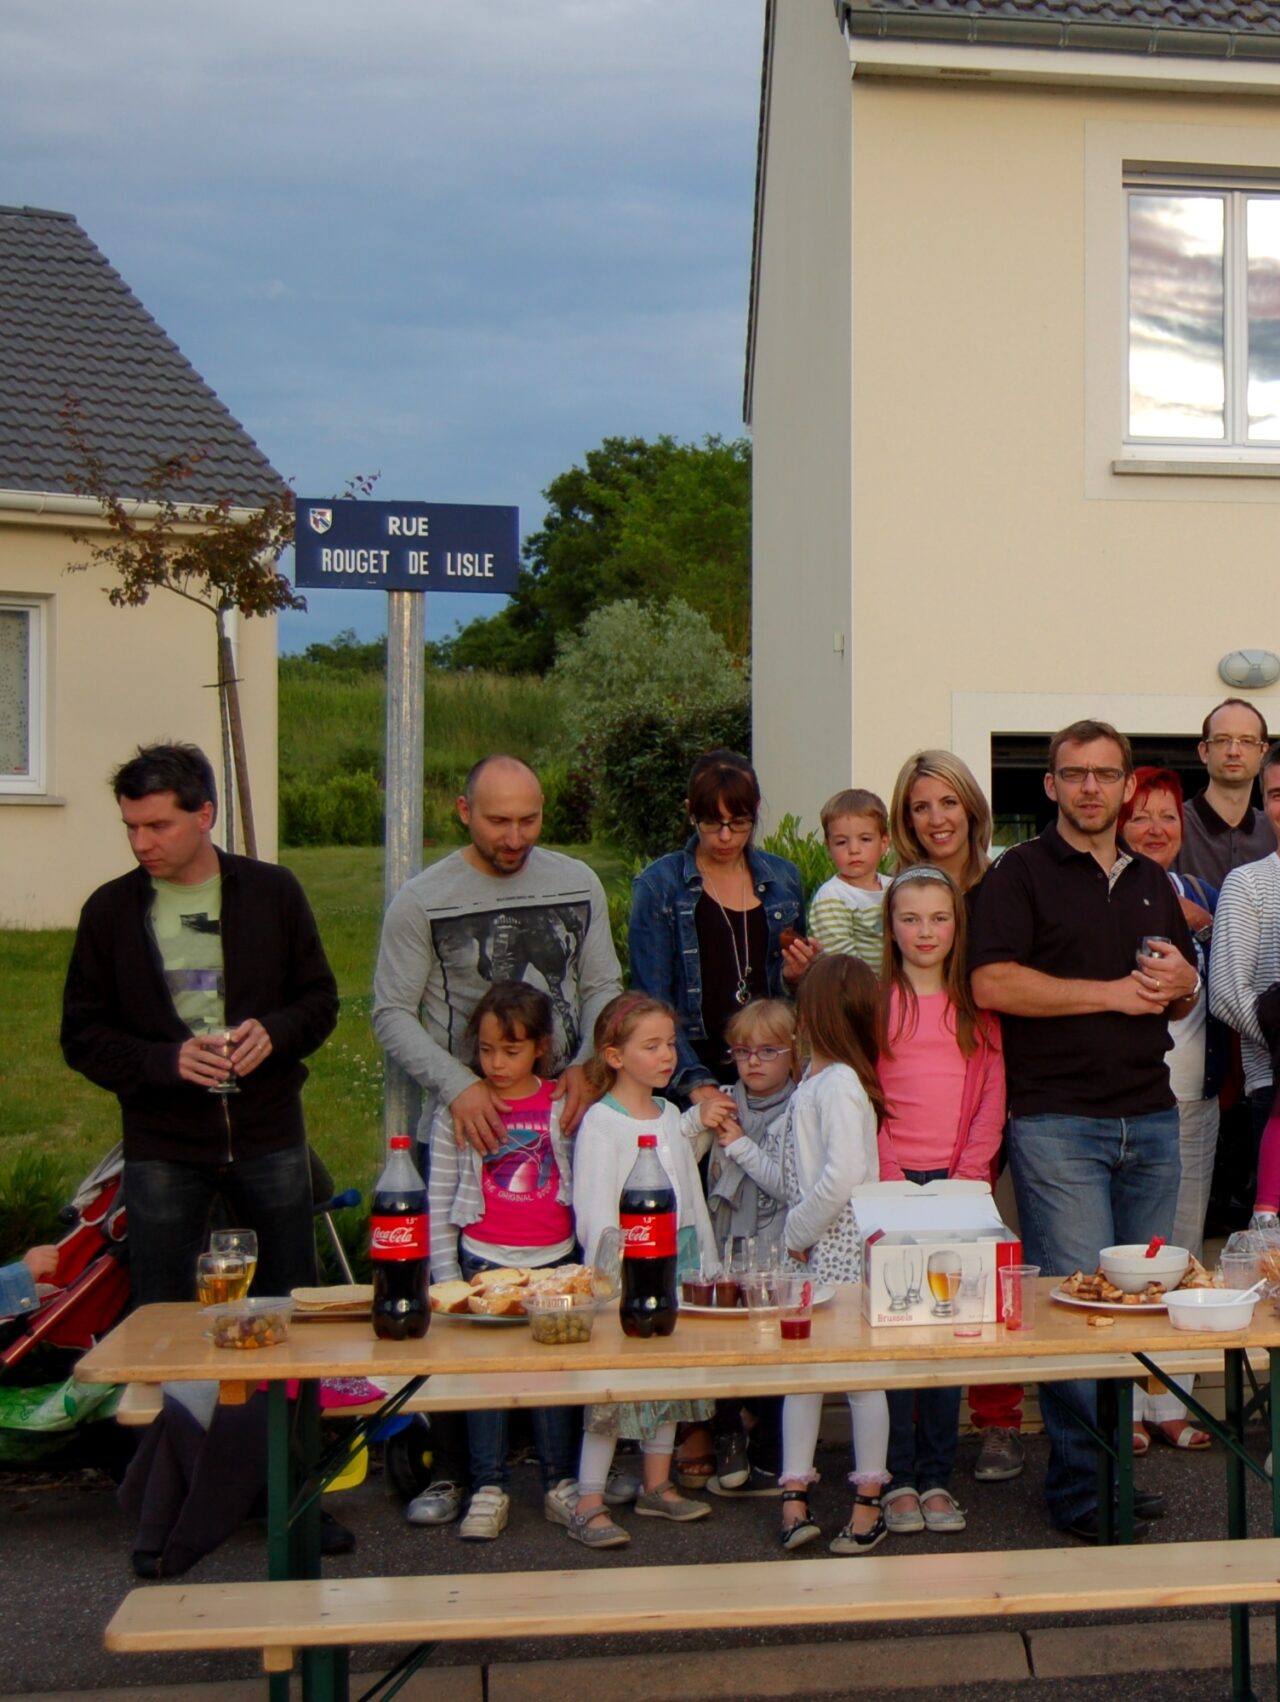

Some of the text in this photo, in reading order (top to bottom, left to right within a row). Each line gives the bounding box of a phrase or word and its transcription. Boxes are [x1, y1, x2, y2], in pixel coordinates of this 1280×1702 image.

[388, 516, 429, 537] RUE
[321, 548, 494, 577] ROUGET DE LISLE
[877, 1313, 913, 1323] Brussels
